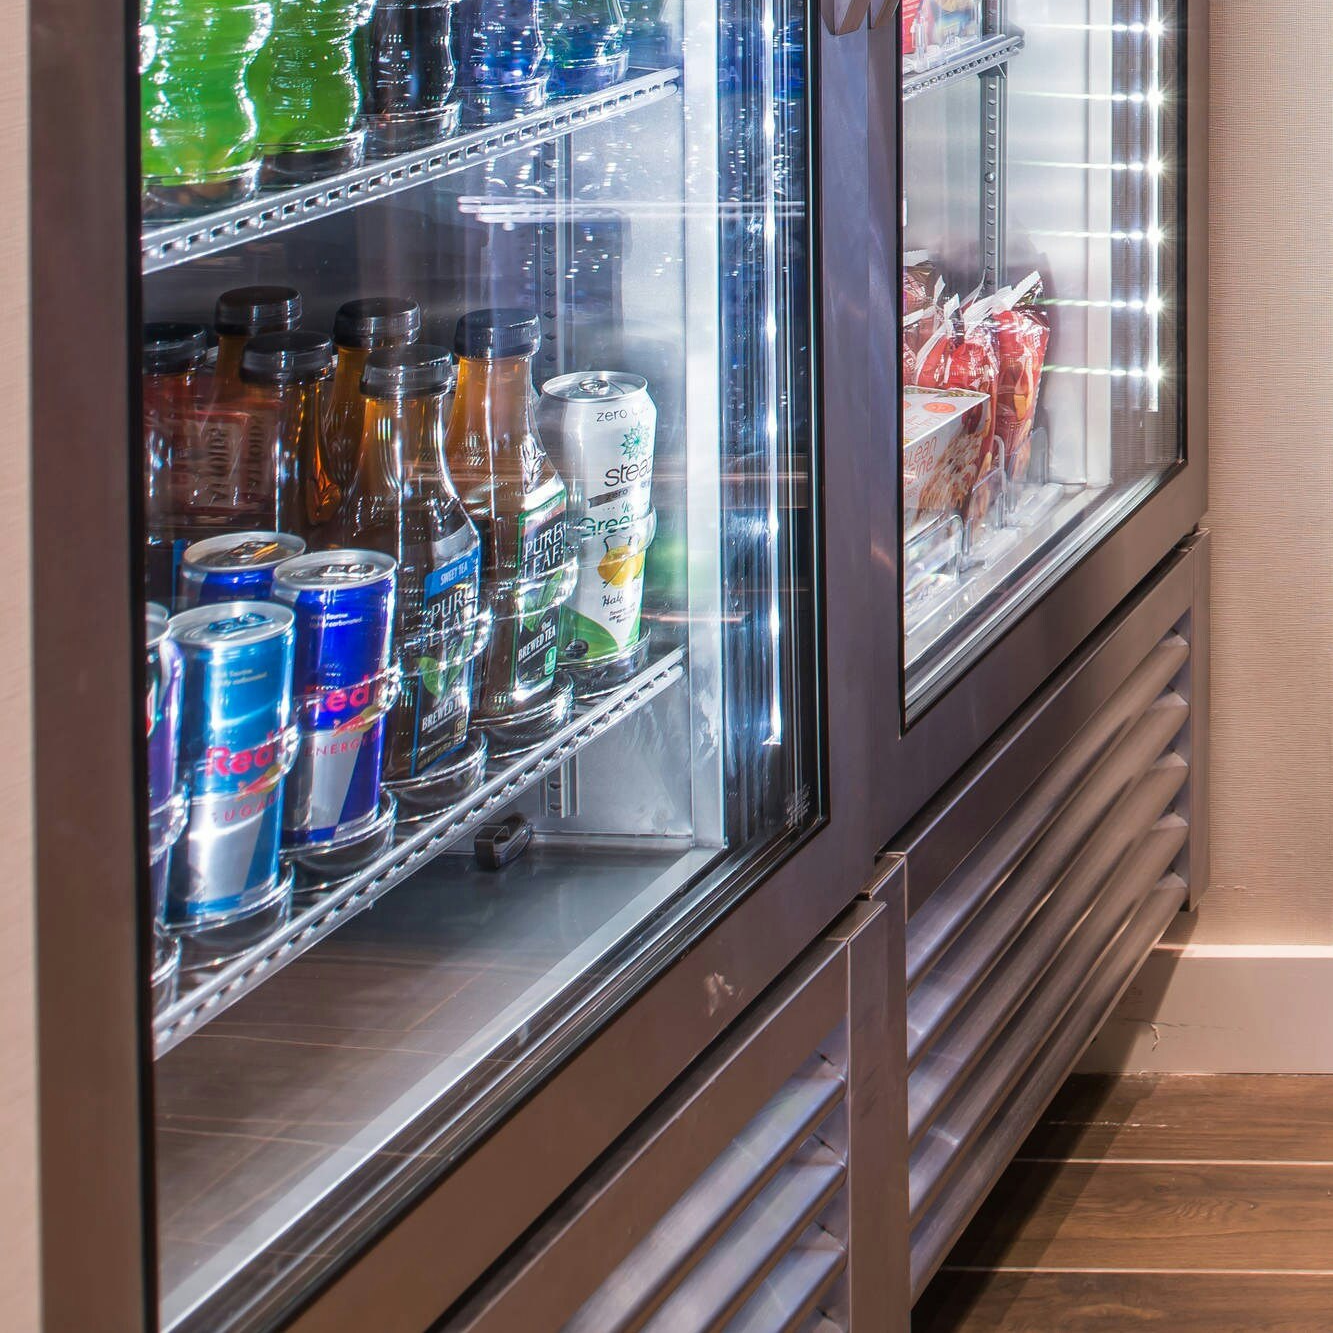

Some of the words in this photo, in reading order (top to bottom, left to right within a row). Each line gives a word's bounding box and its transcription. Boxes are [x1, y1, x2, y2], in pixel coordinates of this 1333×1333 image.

[596, 409, 628, 423] zero
[524, 521, 564, 561] PURE
[440, 567, 457, 586] SWEET
[518, 632, 544, 662] BREWED
[544, 625, 556, 643] TEA
[205, 730, 274, 777] Red
